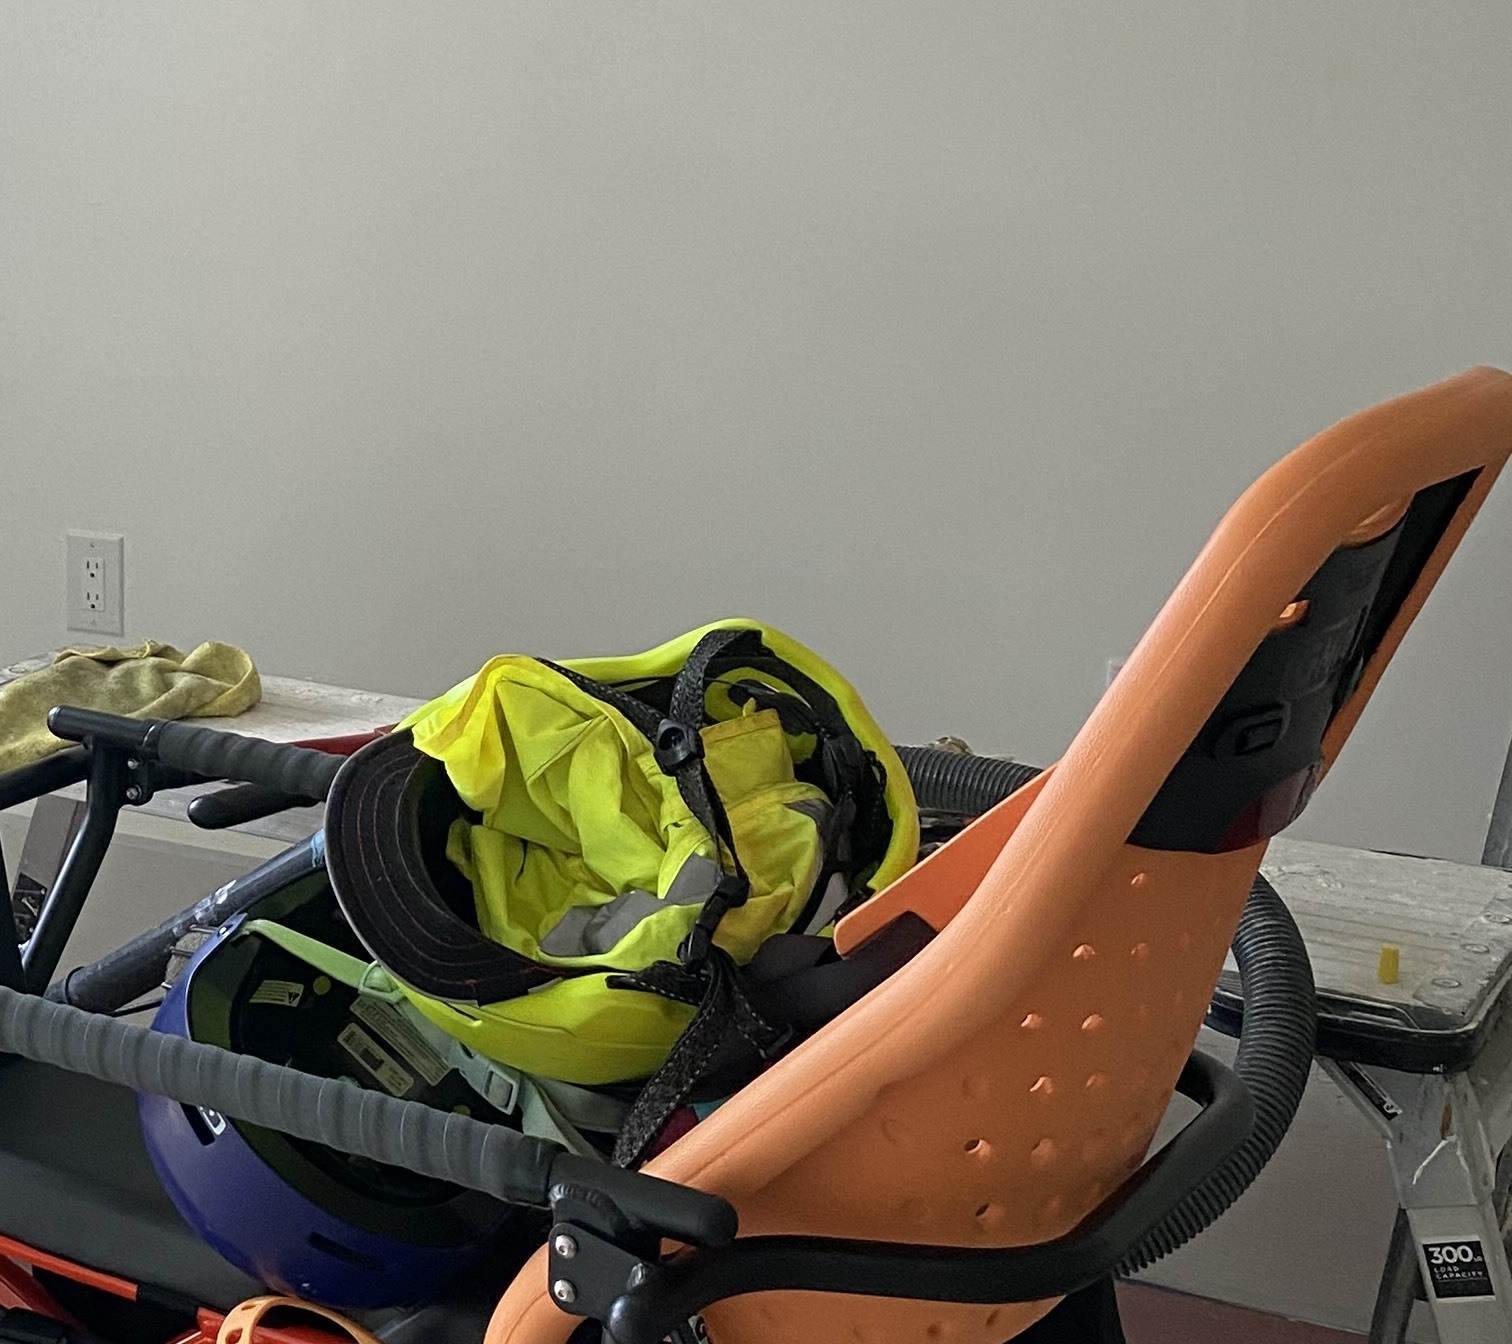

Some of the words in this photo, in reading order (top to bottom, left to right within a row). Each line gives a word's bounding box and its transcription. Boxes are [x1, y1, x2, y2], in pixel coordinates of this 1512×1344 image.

[1428, 1245, 1473, 1264] 300
[1433, 1265, 1460, 1274] LOAD
[1435, 1270, 1483, 1280] CAPACITY
